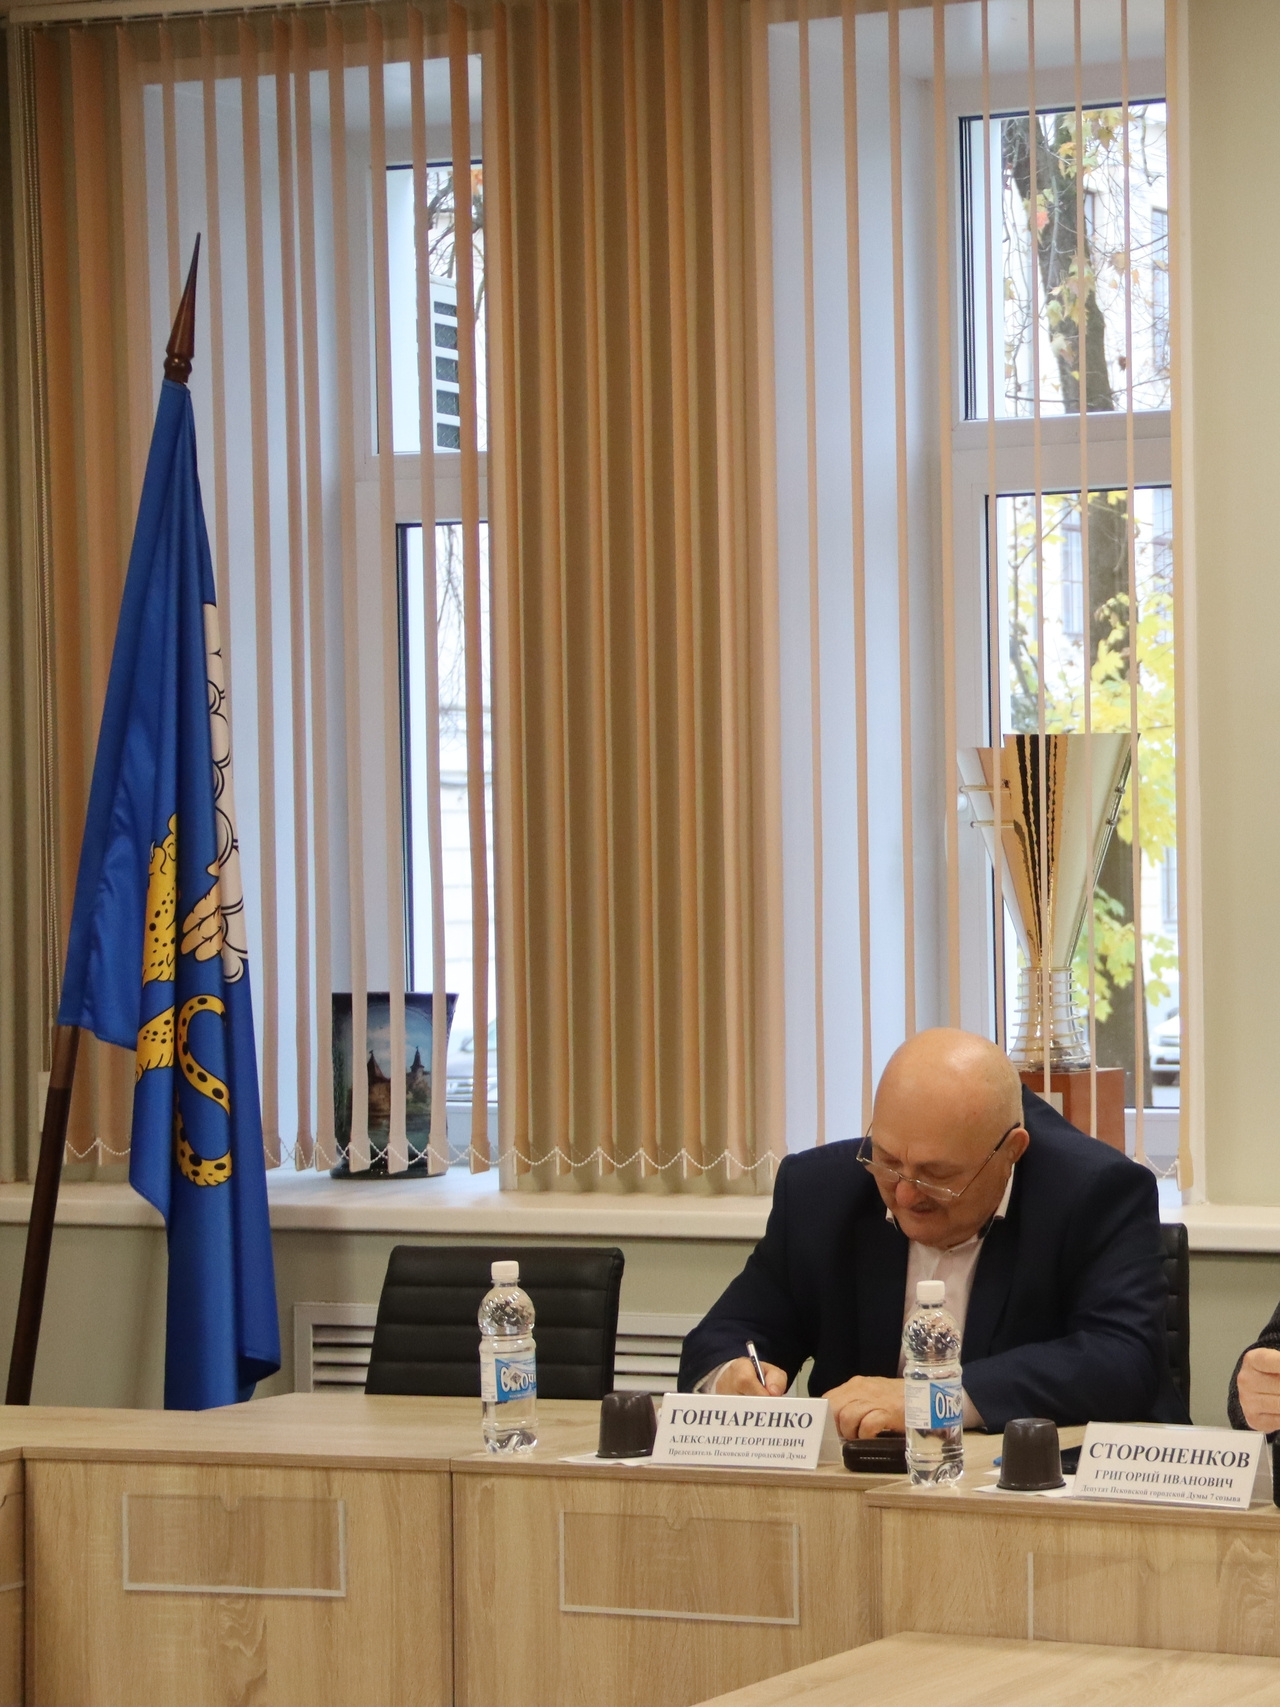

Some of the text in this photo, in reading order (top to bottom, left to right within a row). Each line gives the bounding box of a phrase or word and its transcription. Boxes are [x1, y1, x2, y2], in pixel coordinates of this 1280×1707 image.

[669, 1408, 813, 1429] ГОНЧАРЕНКО
[669, 1434, 805, 1448] АЛЕКСАНДР ГЕОРГИЕВИЧ
[668, 1448, 807, 1461] Председатель Псковской городской Думы
[1089, 1441, 1250, 1469] СТОРОНЕНКОВ
[1094, 1469, 1233, 1489] ГРИГОРИЙ ИВАНОВИЧ
[1081, 1484, 1109, 1493] Депутат
[1110, 1486, 1148, 1496] Псковской
[1149, 1489, 1185, 1498] городской
[1186, 1491, 1208, 1501] Думы
[1215, 1494, 1241, 1503] созыва
